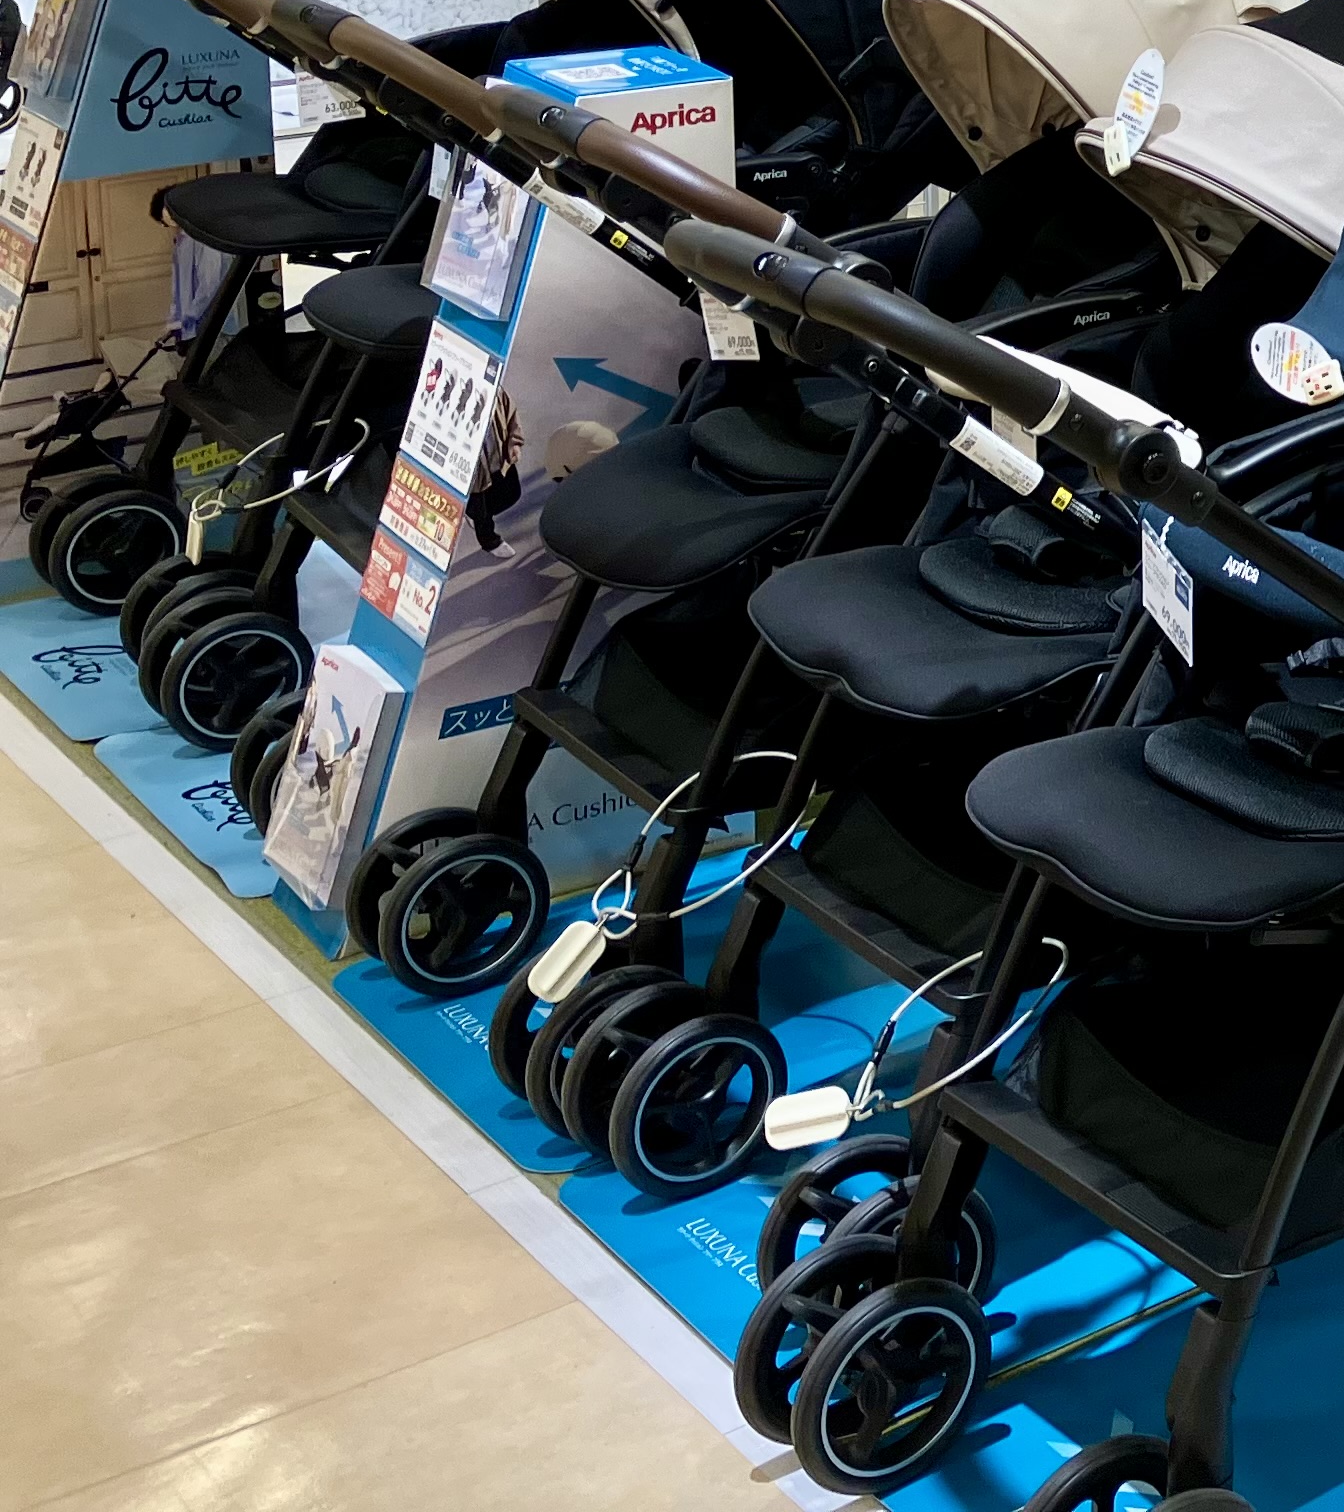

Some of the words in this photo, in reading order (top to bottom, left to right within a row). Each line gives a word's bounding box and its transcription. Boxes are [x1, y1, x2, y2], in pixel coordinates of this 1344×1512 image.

[630, 102, 717, 136] Aprica
[753, 169, 788, 182] Aprica
[1073, 309, 1111, 327] Aprica
[1222, 554, 1261, 585] Aprica
[685, 1217, 748, 1271] LUXUNA
